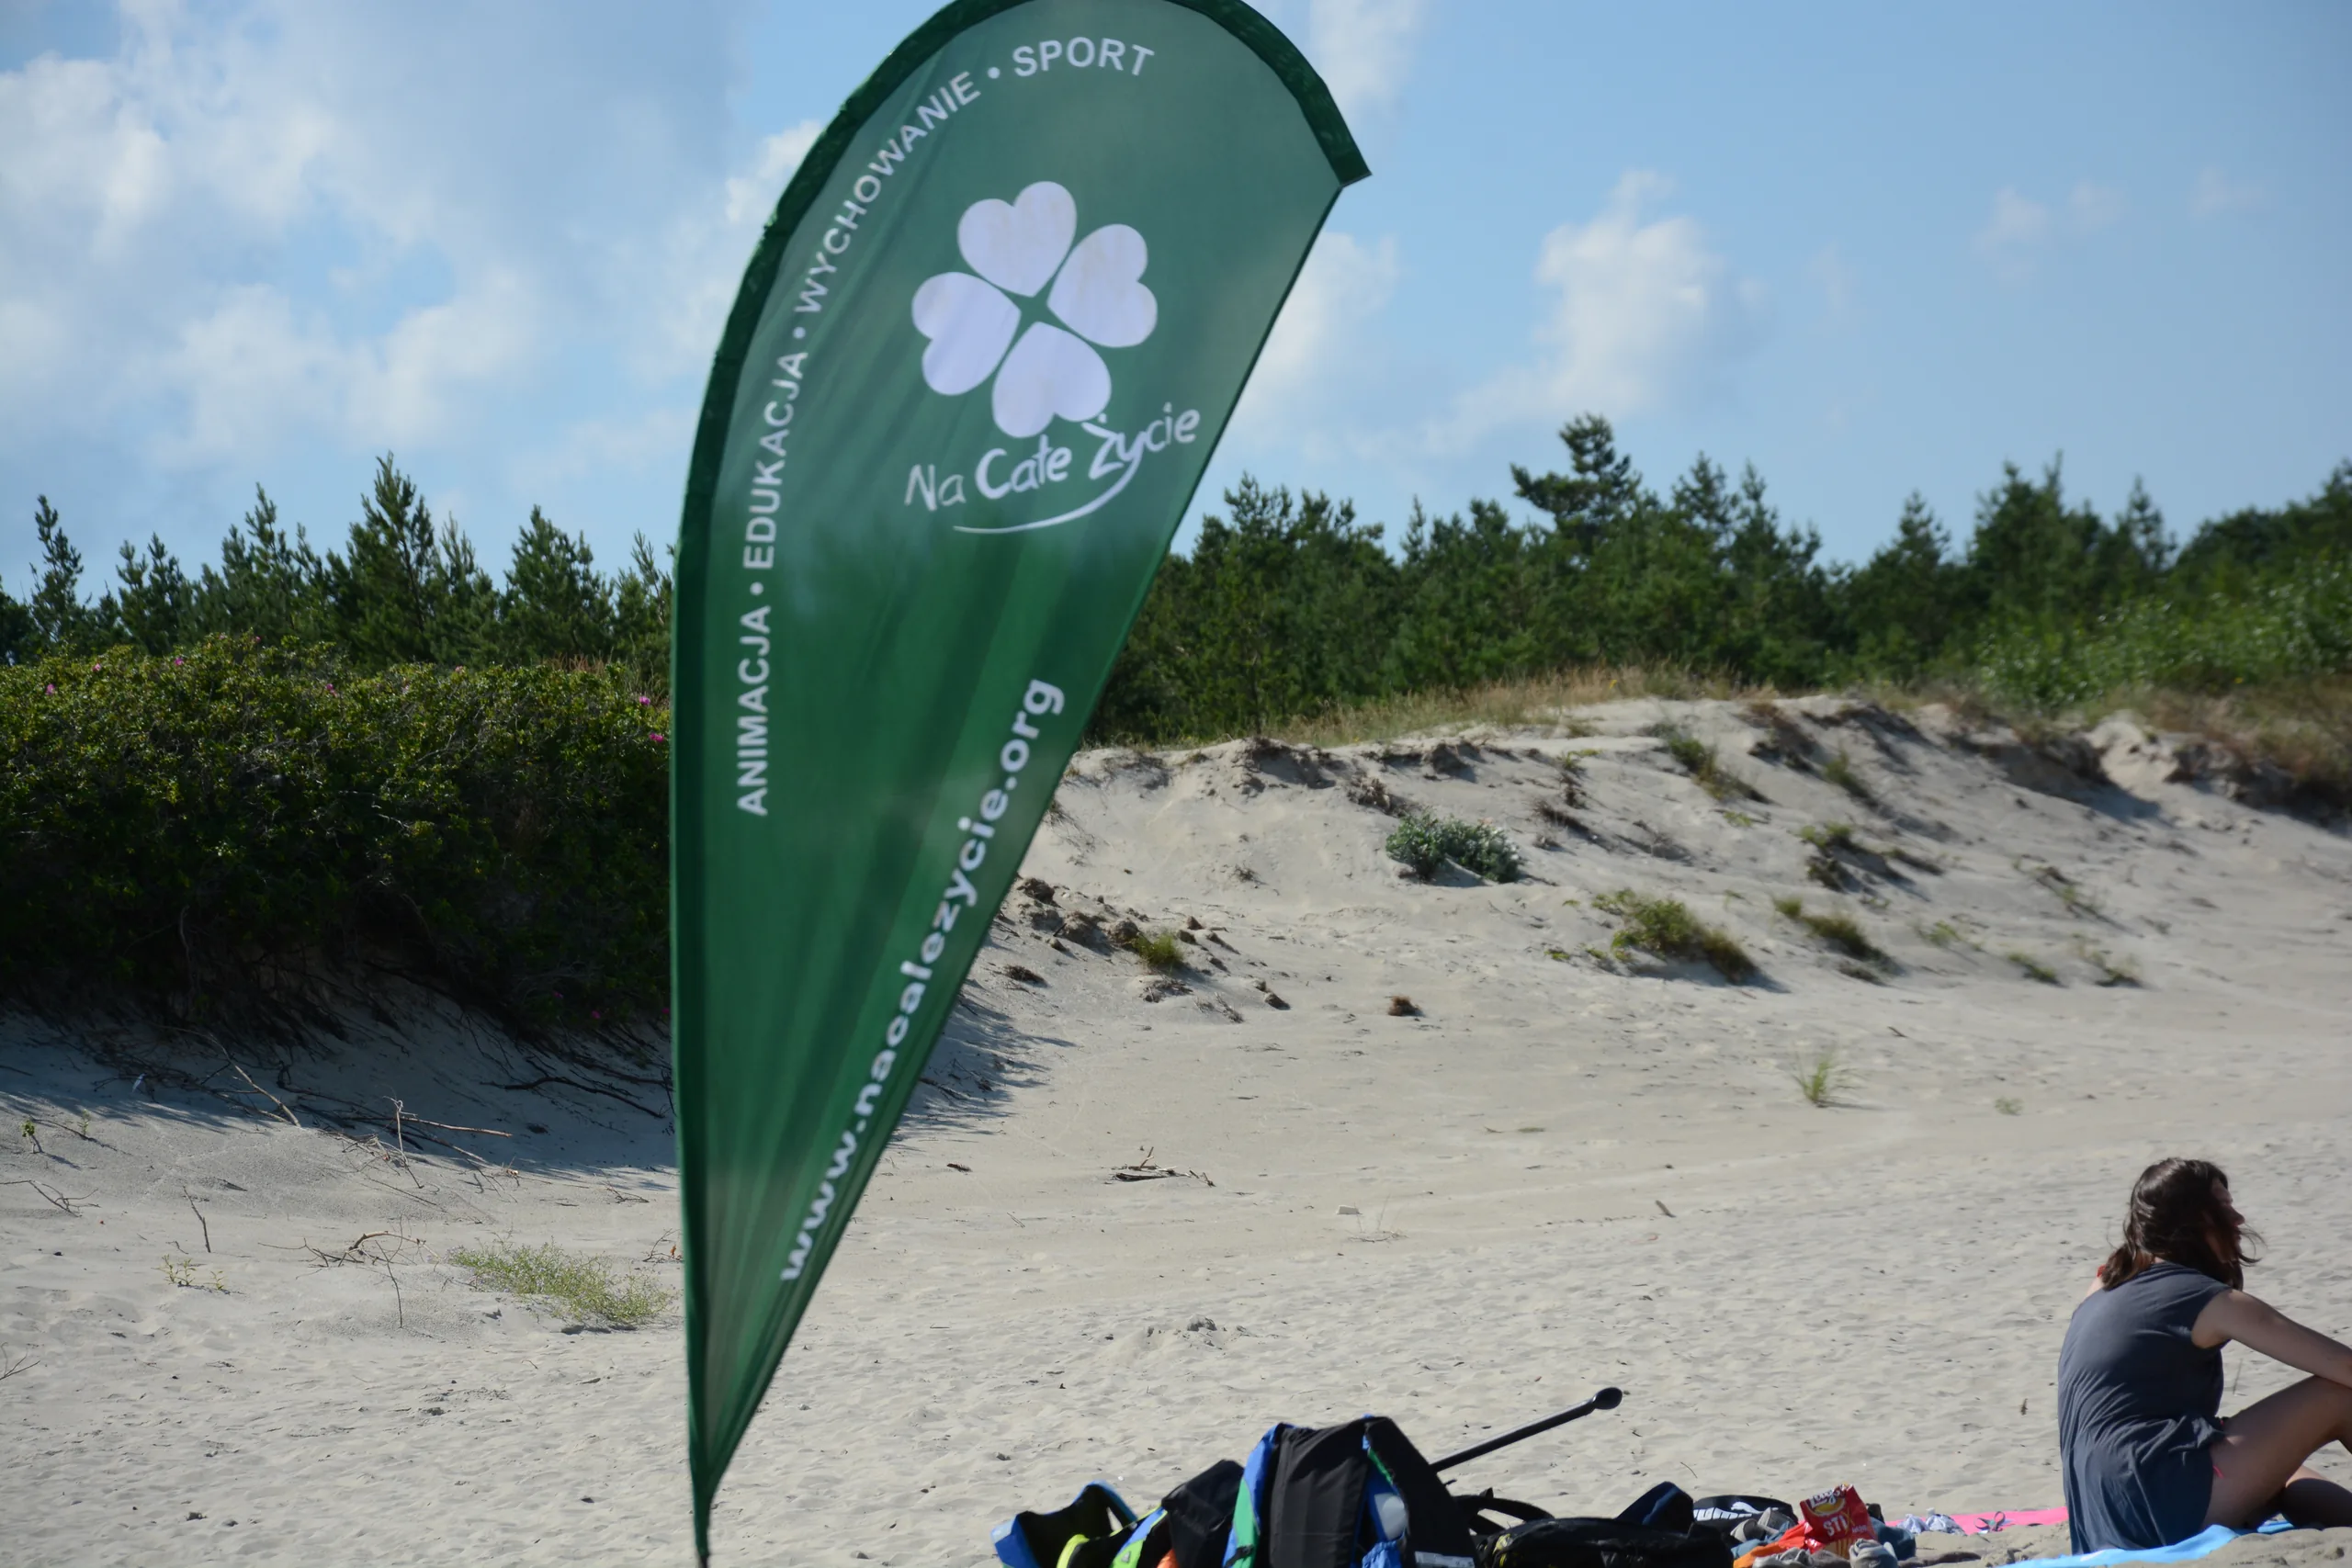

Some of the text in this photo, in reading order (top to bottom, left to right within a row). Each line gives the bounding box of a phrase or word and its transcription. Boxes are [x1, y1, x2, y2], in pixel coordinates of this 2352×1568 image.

[738, 37, 1154, 816] ANIMACJA EDUKACJA WYCHOWANIE SPORT
[905, 401, 1200, 511] Na Całe Życie
[780, 680, 1066, 1281] www.nacalezycie.org
